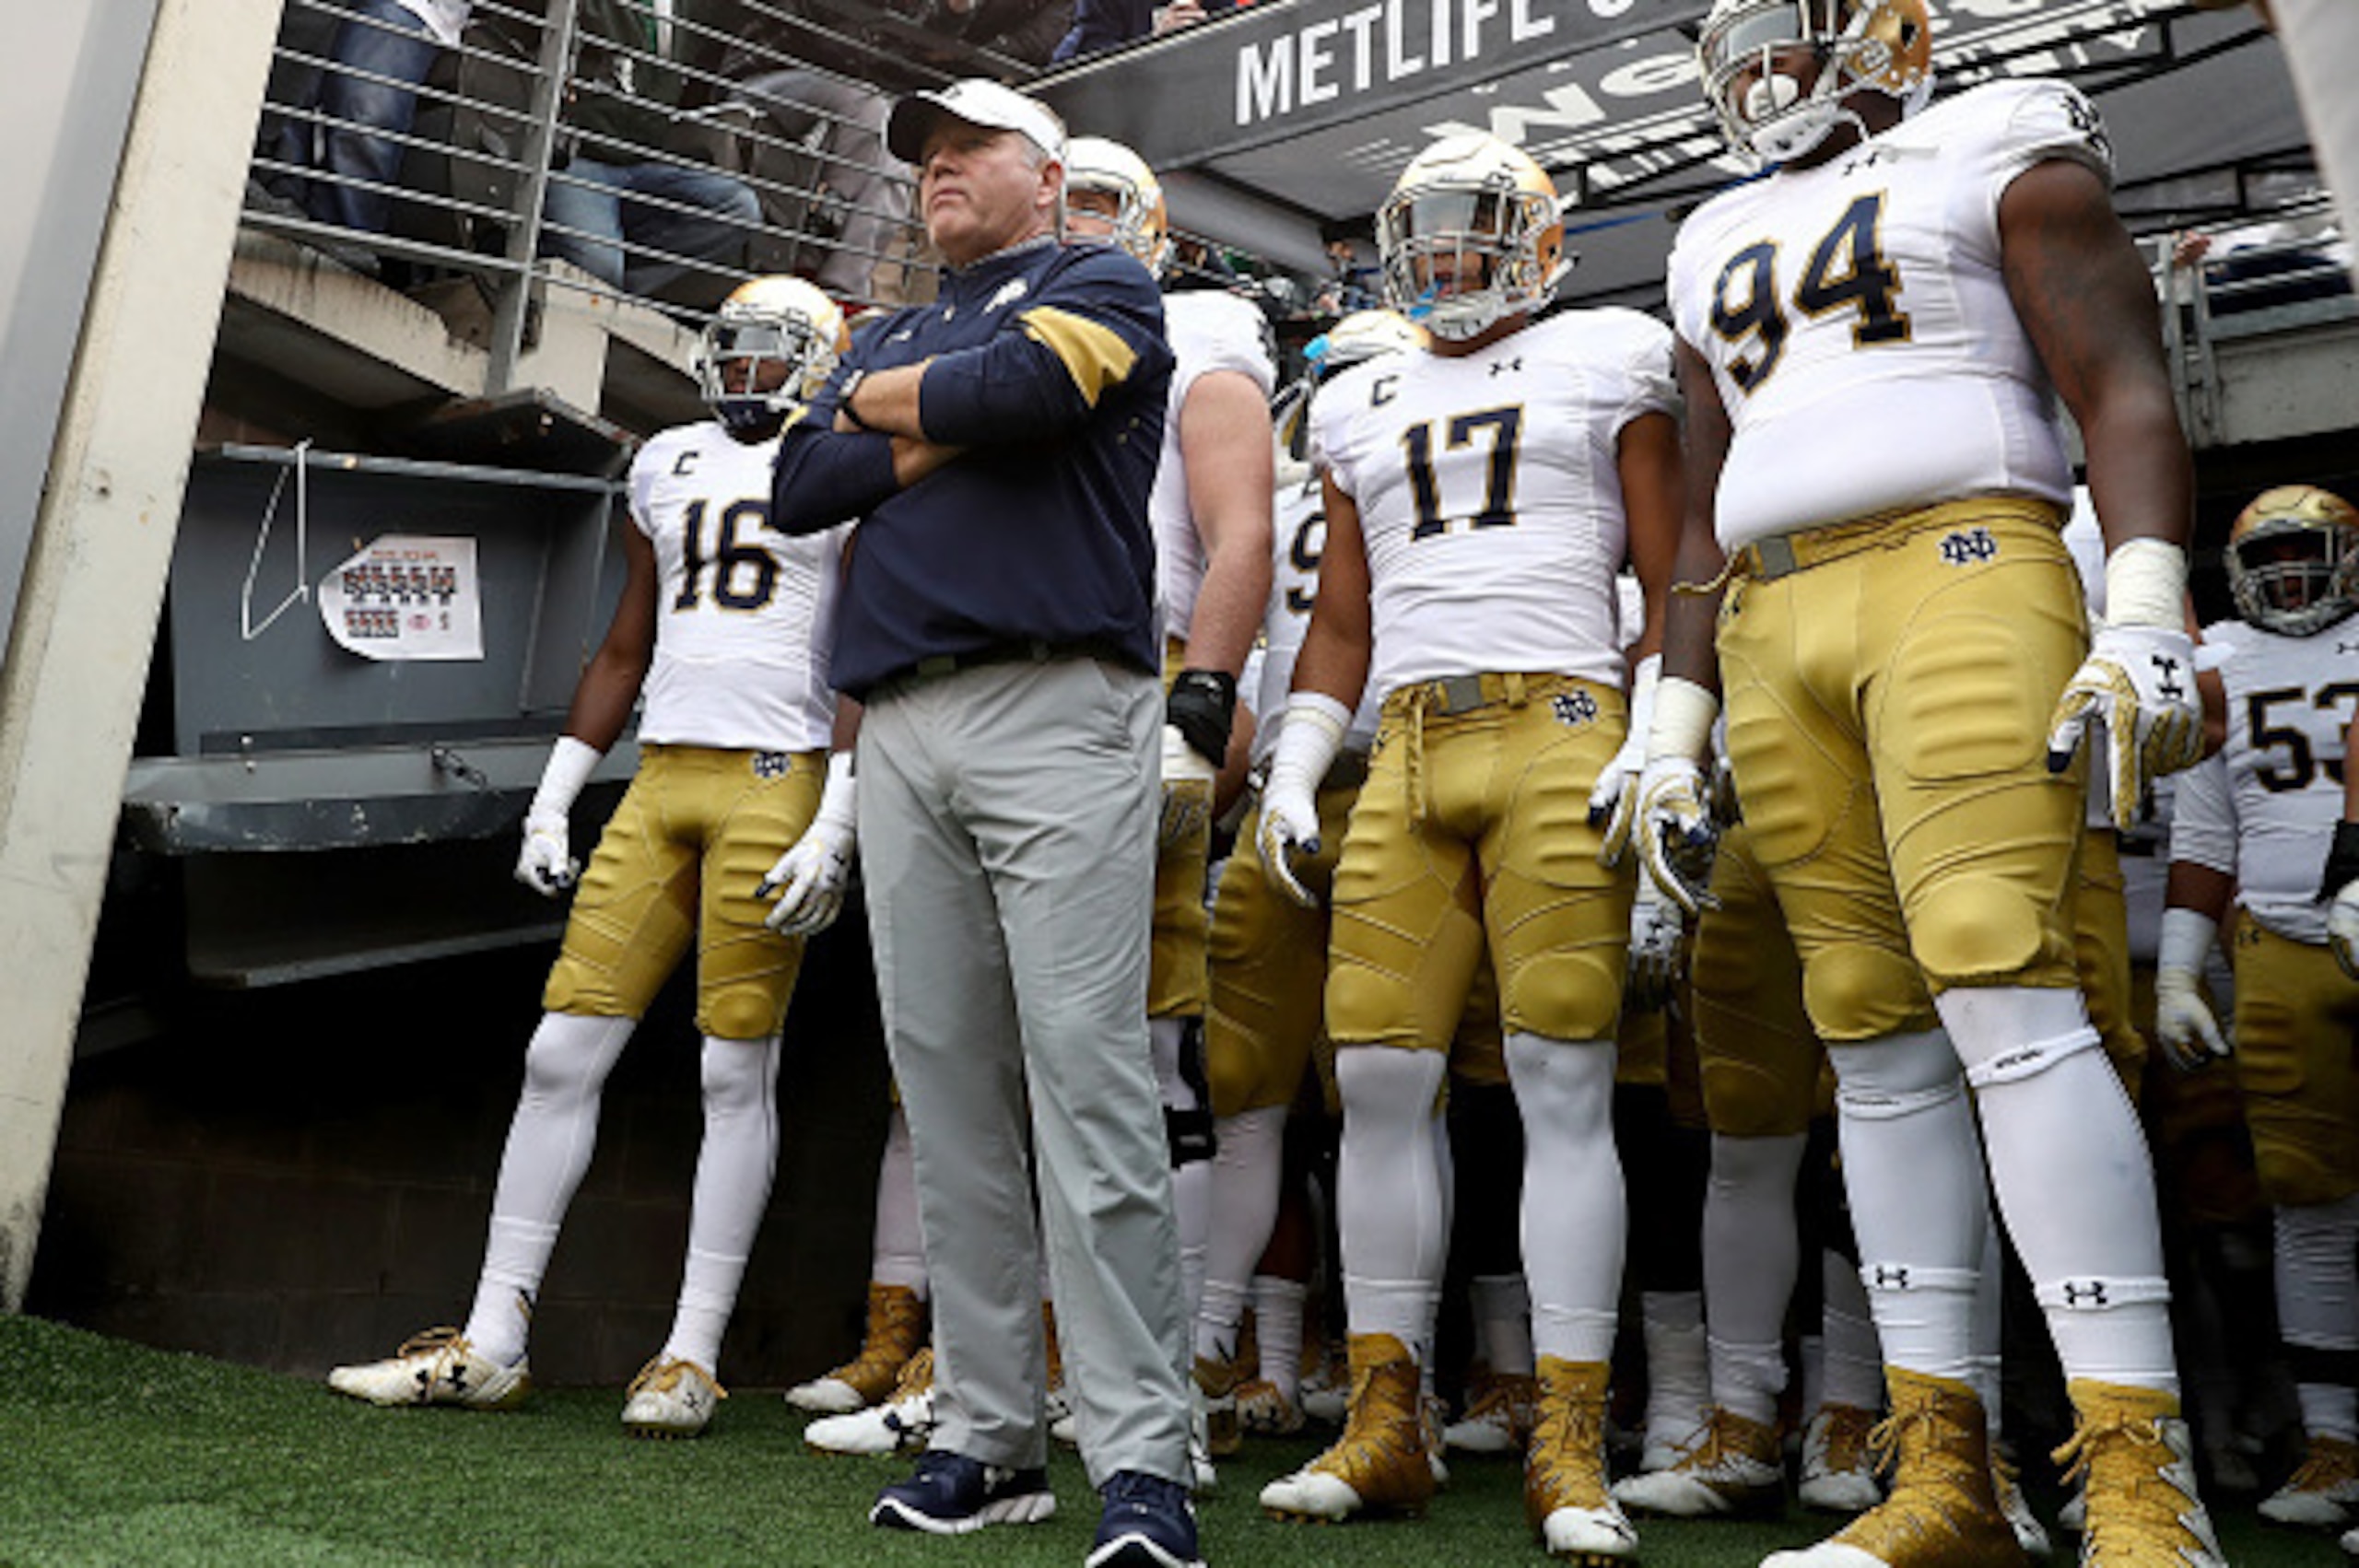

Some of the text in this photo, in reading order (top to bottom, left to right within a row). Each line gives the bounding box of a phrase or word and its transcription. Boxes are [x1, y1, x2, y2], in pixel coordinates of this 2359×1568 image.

[1708, 189, 1912, 397] 94
[1369, 374, 1401, 407] C
[671, 450, 699, 476] C
[1397, 402, 1526, 543] 17
[671, 497, 781, 615] 16
